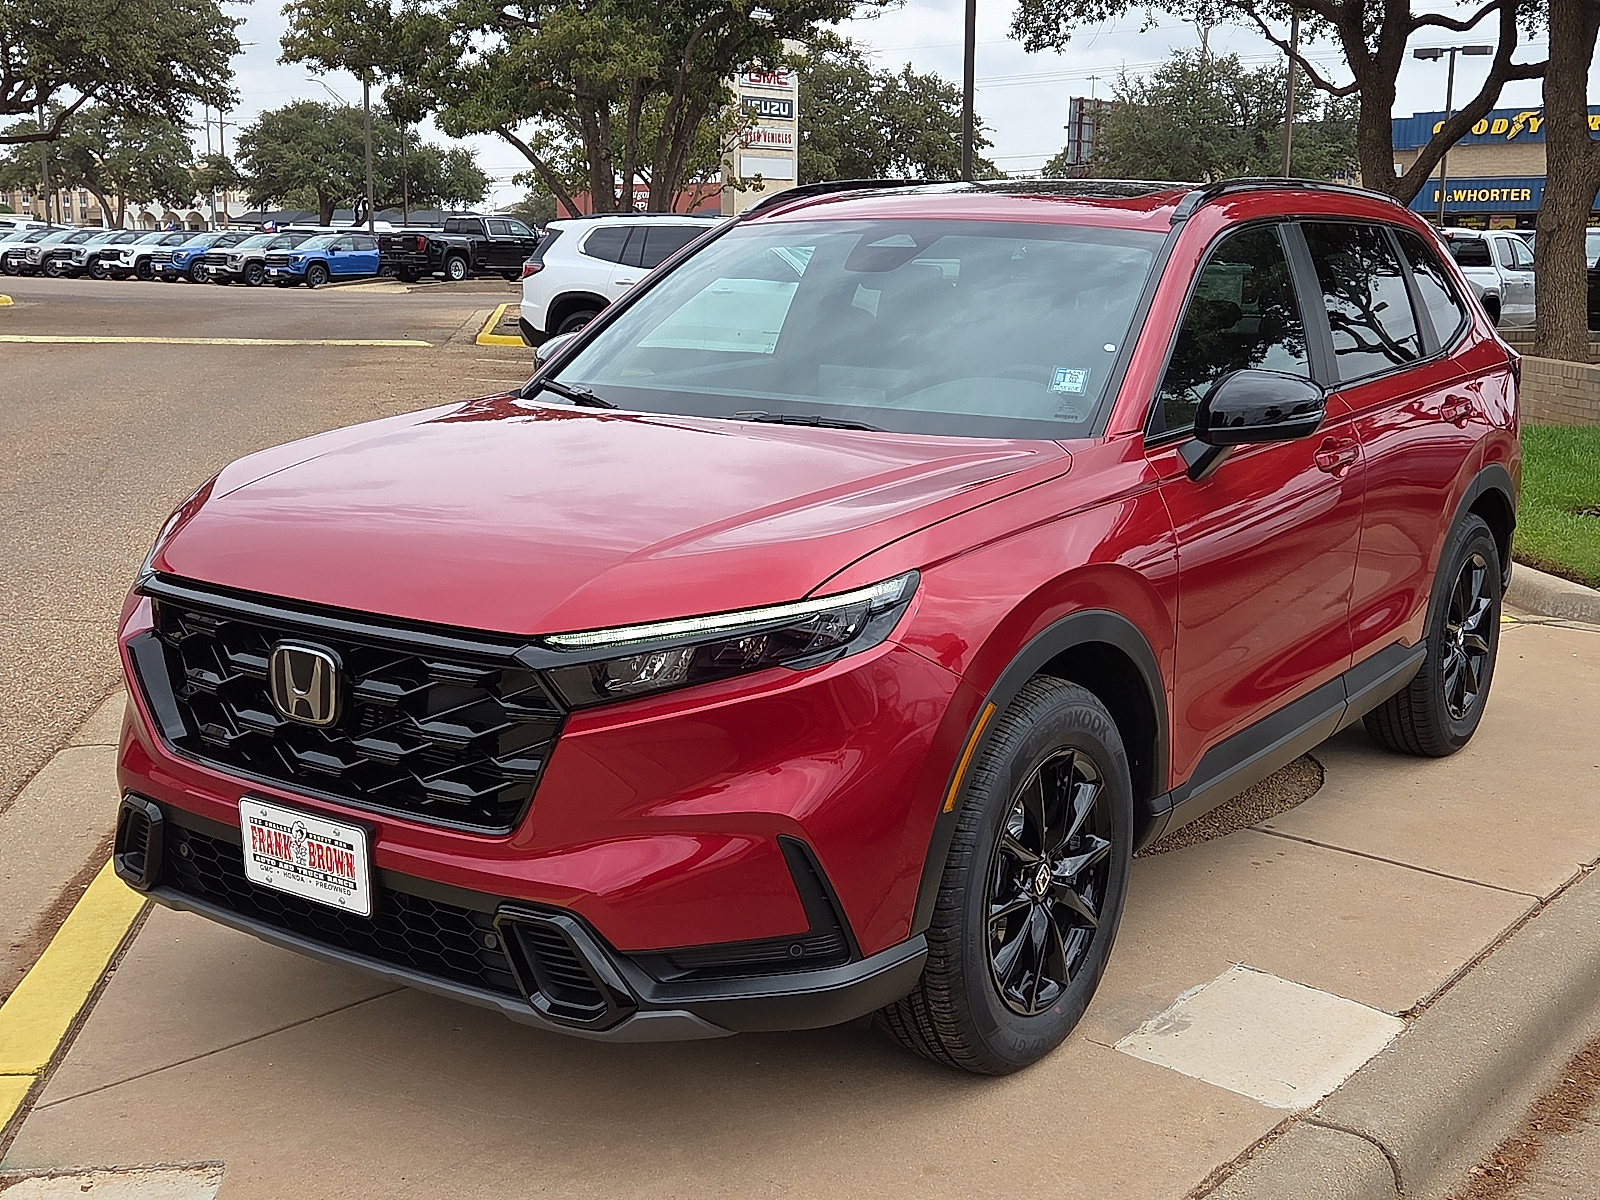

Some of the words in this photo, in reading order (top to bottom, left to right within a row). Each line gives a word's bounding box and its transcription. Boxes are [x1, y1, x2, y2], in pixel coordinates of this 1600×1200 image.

[749, 71, 788, 86] GMC
[747, 99, 789, 116] ISUZU
[763, 131, 792, 144] VEHICLES
[1434, 188, 1531, 203] McWHORTER
[250, 825, 293, 862] FRANK
[307, 841, 356, 880] BROWN
[255, 855, 277, 866] AUTO
[279, 862, 295, 871] AND
[297, 867, 325, 880] TRUCK
[327, 876, 355, 888] RANCH
[259, 864, 274, 874] GMC
[282, 871, 306, 883] HONDA
[315, 880, 352, 896] PREOWNED
